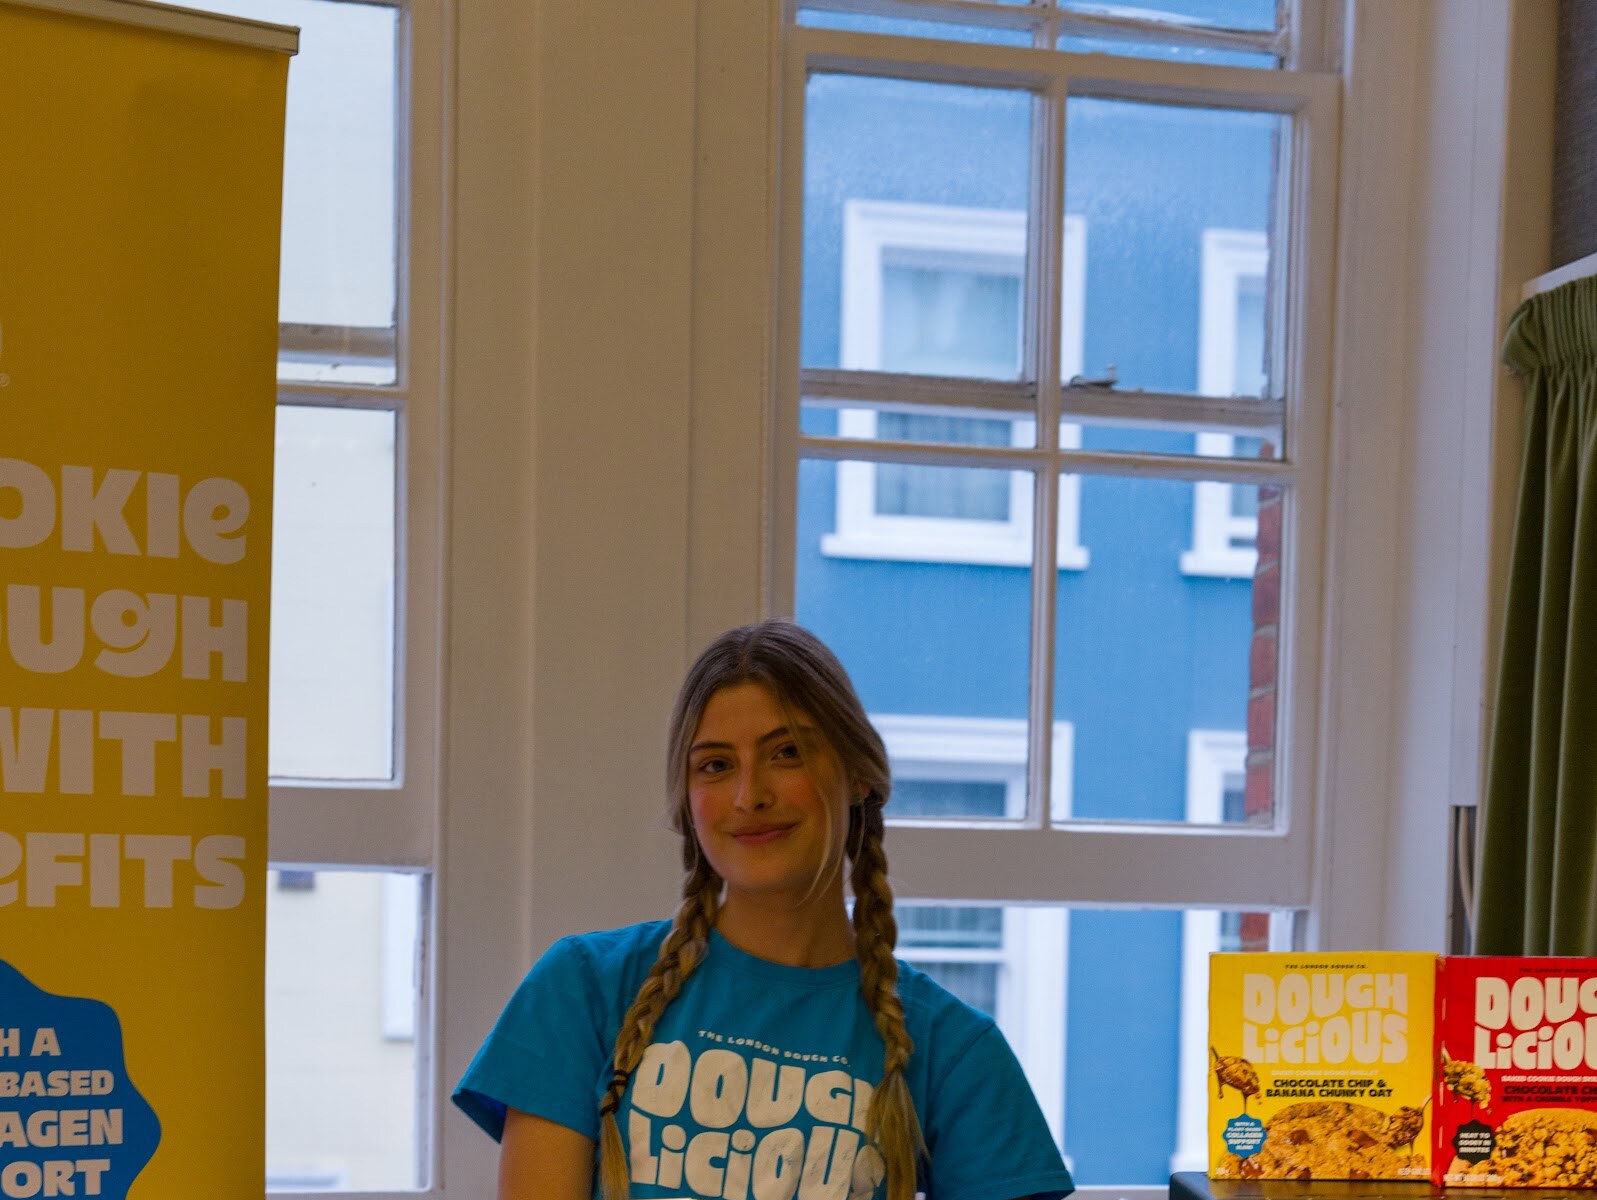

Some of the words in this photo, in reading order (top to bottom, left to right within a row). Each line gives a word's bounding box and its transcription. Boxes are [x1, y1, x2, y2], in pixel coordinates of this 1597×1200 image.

[1243, 973, 1408, 1025] DOUGH
[30, 1027, 62, 1057] A
[698, 1030, 723, 1042] THE
[728, 1036, 780, 1055] LONDON
[783, 1051, 828, 1063] DOUGH
[0, 1069, 115, 1098] BASED
[1266, 1089, 1315, 1098] BANANA
[1319, 1089, 1365, 1098] CHUNKY
[1368, 1089, 1393, 1098] OAT
[1273, 1079, 1344, 1088] CHOCOLATE
[1347, 1079, 1374, 1088] CHIP
[1377, 1079, 1387, 1088] &
[1504, 1086, 1578, 1095] CHOCOLATE
